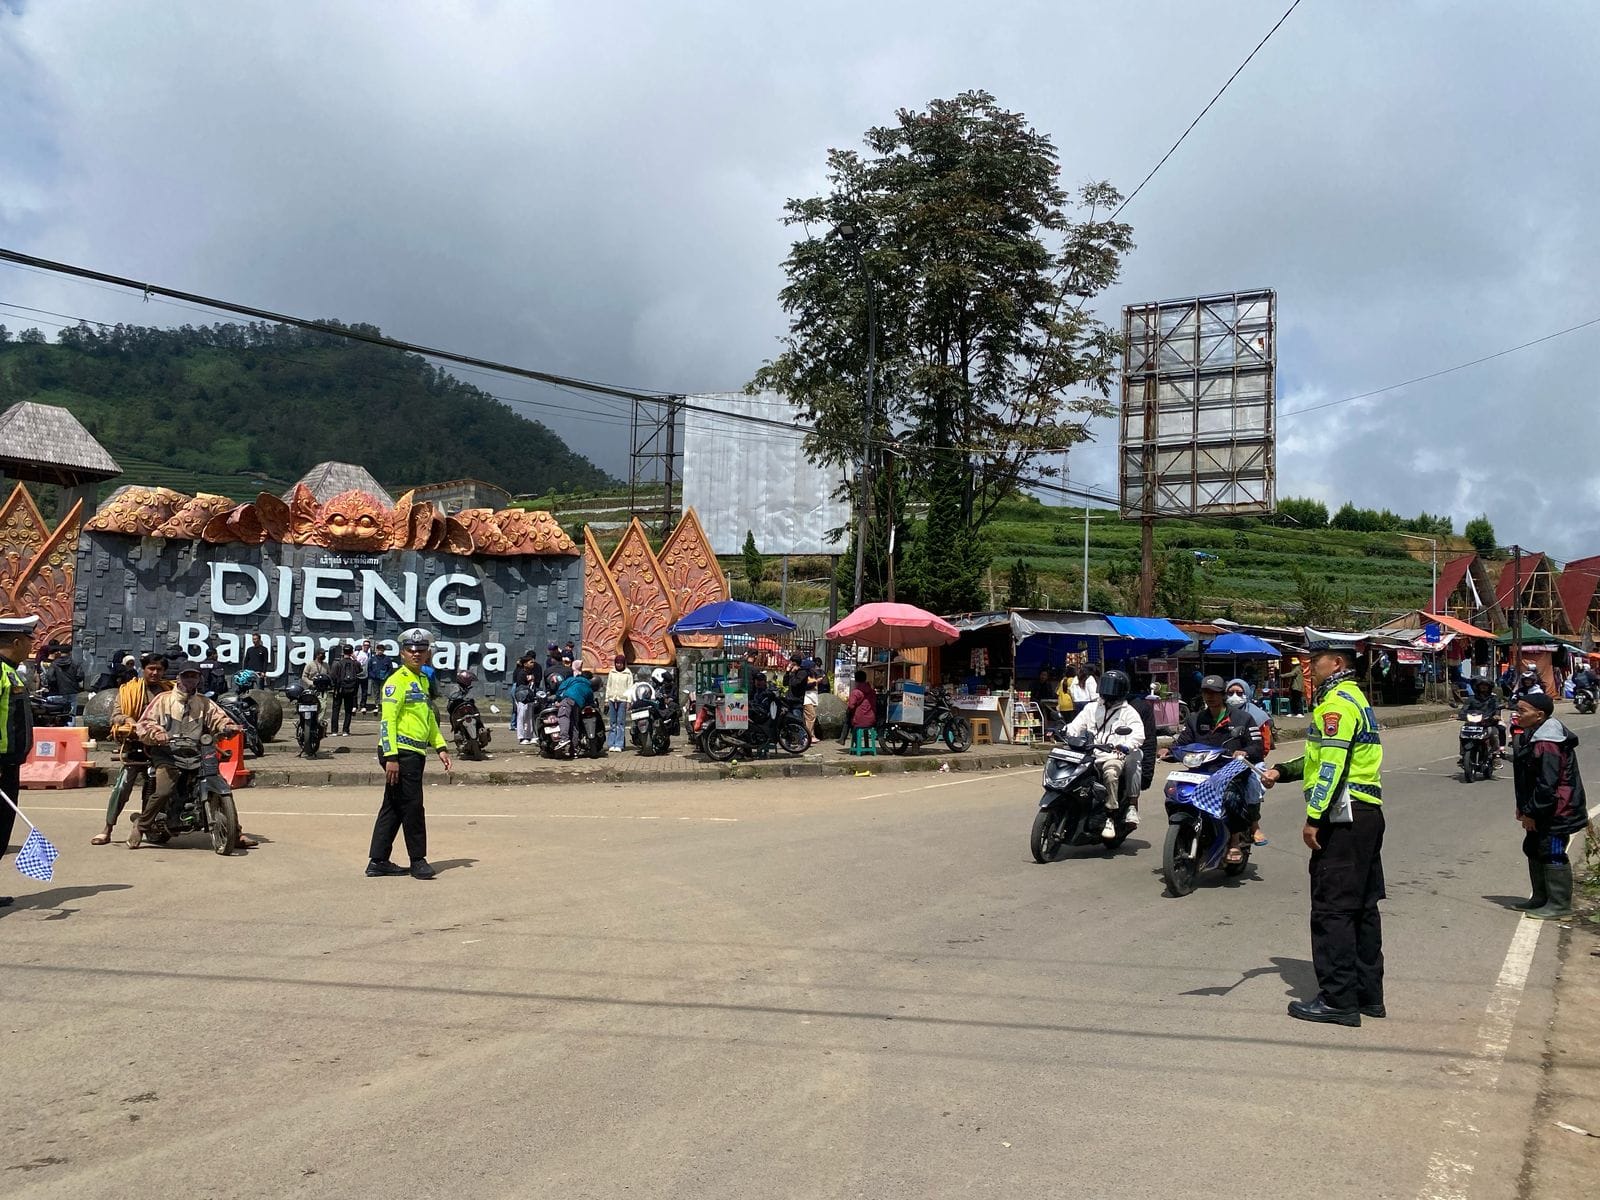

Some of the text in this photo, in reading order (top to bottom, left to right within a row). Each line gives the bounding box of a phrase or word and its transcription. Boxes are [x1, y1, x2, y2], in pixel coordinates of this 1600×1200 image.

[207, 561, 482, 626] DIENG
[178, 621, 506, 677] Banjareara
[1309, 761, 1336, 810] POLISI
